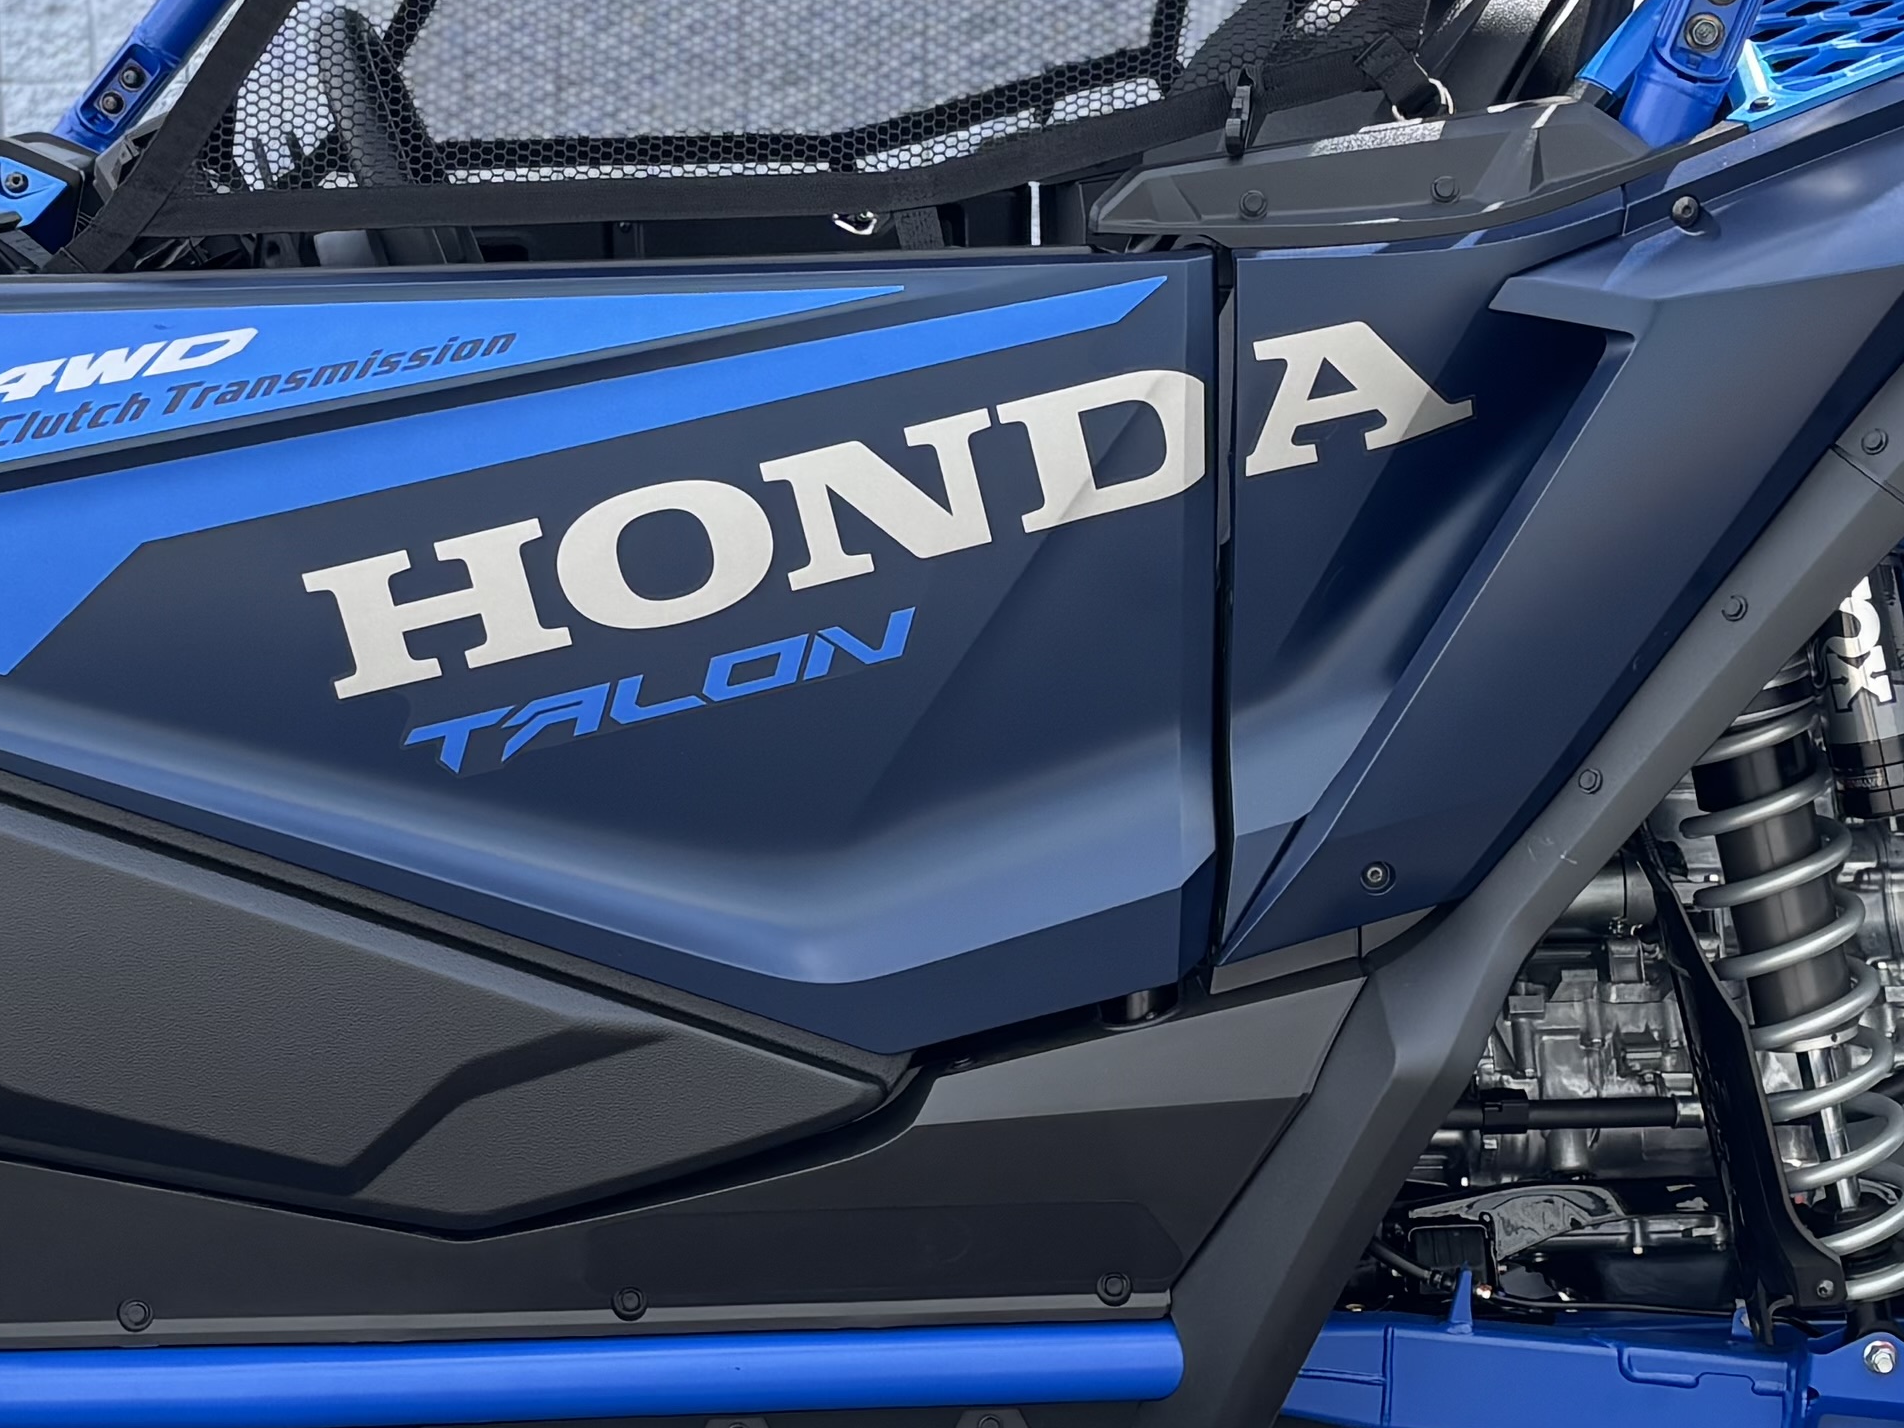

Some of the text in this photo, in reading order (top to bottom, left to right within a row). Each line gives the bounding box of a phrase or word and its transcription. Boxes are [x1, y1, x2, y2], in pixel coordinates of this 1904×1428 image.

[161, 332, 517, 415] Transmission
[302, 321, 1474, 699] HONDA
[405, 608, 916, 773] TALON
